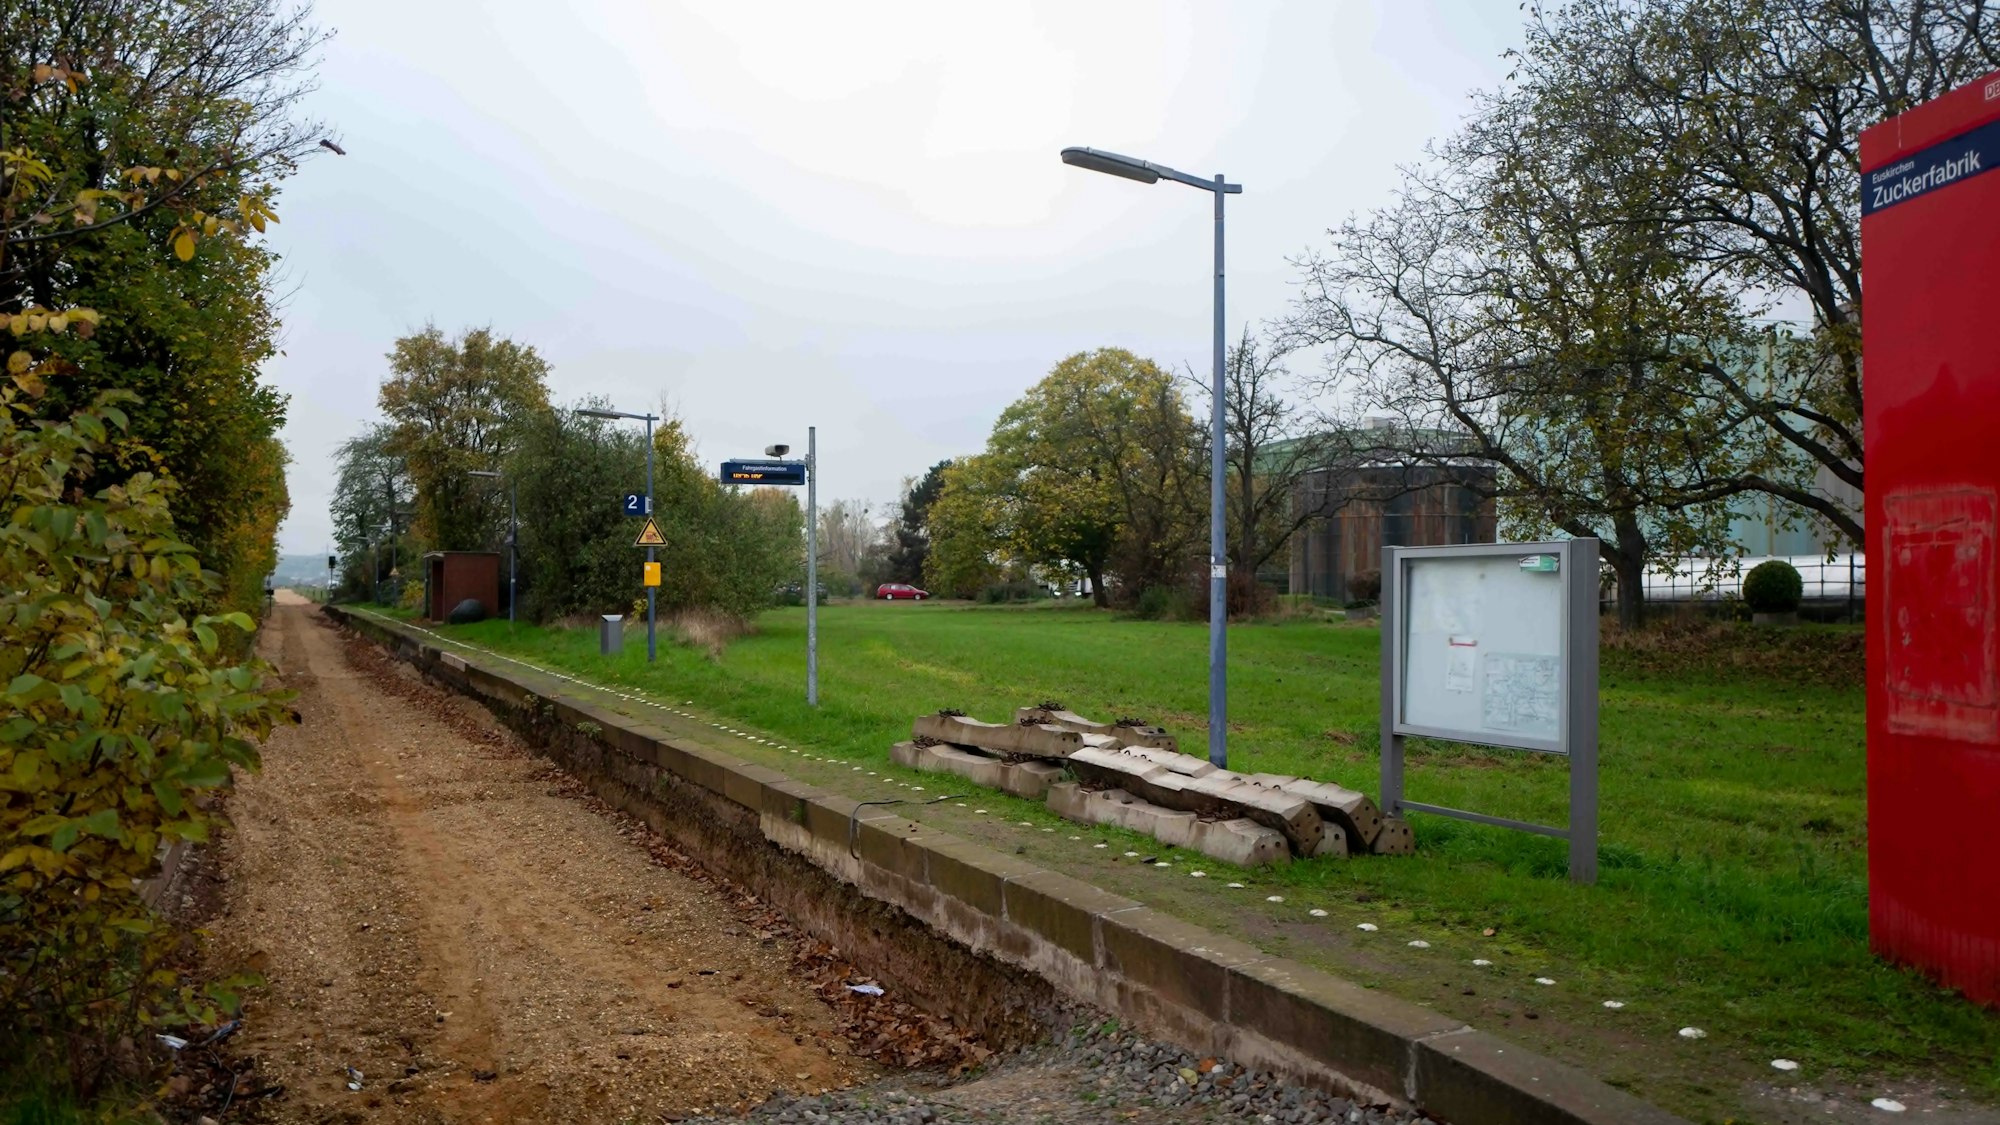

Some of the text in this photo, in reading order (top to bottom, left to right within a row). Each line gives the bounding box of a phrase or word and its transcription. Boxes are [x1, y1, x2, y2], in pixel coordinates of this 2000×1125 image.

[1987, 82, 2000, 98] DB
[1872, 160, 1915, 184] Euskirchen
[1872, 149, 1981, 208] Zuckerfabrik
[628, 494, 638, 509] 2
